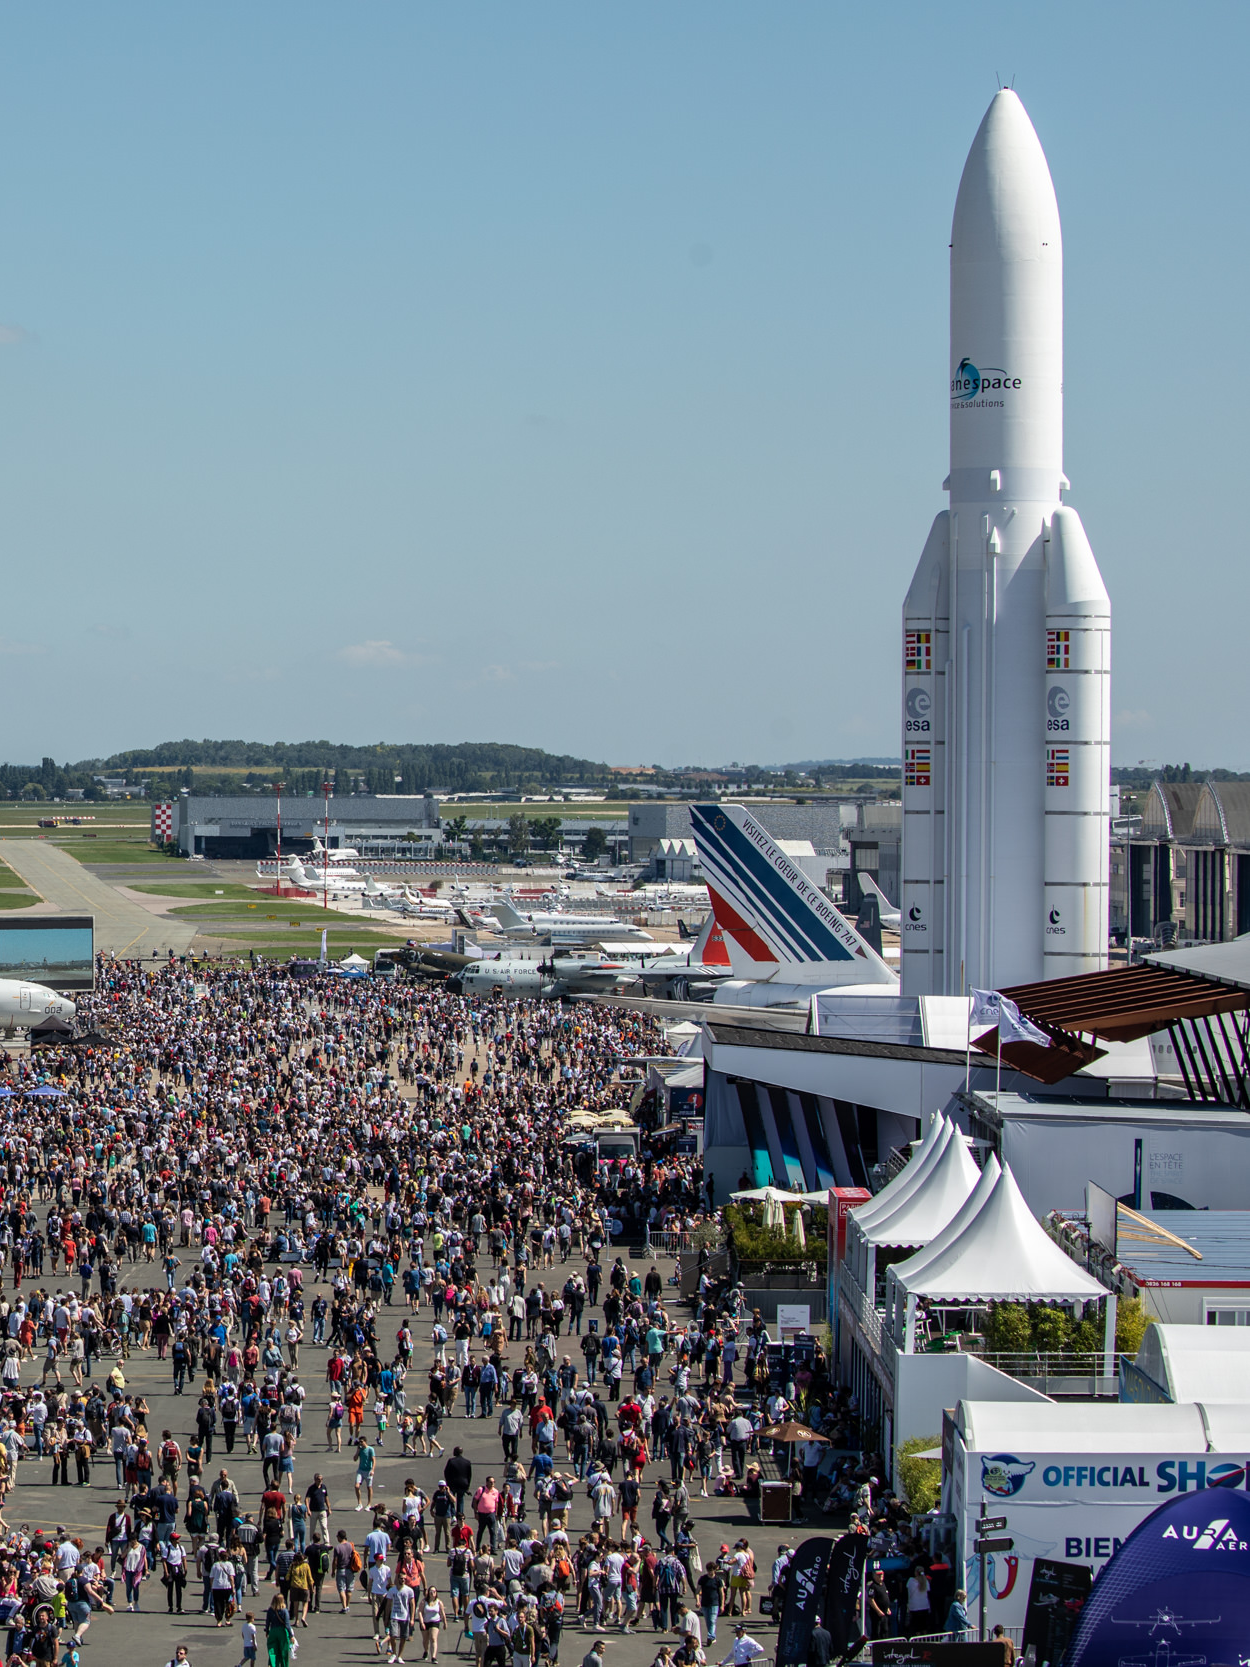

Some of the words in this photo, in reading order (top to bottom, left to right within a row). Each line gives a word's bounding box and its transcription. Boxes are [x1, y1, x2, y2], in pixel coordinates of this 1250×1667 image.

[906, 720, 930, 731] esa
[1047, 719, 1069, 731] esa
[743, 819, 768, 849] VISITEZ
[765, 846, 777, 859] LE
[774, 856, 798, 884] COEUR
[796, 881, 810, 896] DE
[806, 892, 818, 906] CE
[815, 902, 844, 933] BOEING
[841, 930, 857, 946] 747
[1046, 926, 1066, 935] cnes
[1043, 1466, 1150, 1487] OFFICIAL
[811, 1556, 822, 1582] AERO
[883, 1648, 921, 1664] integral
